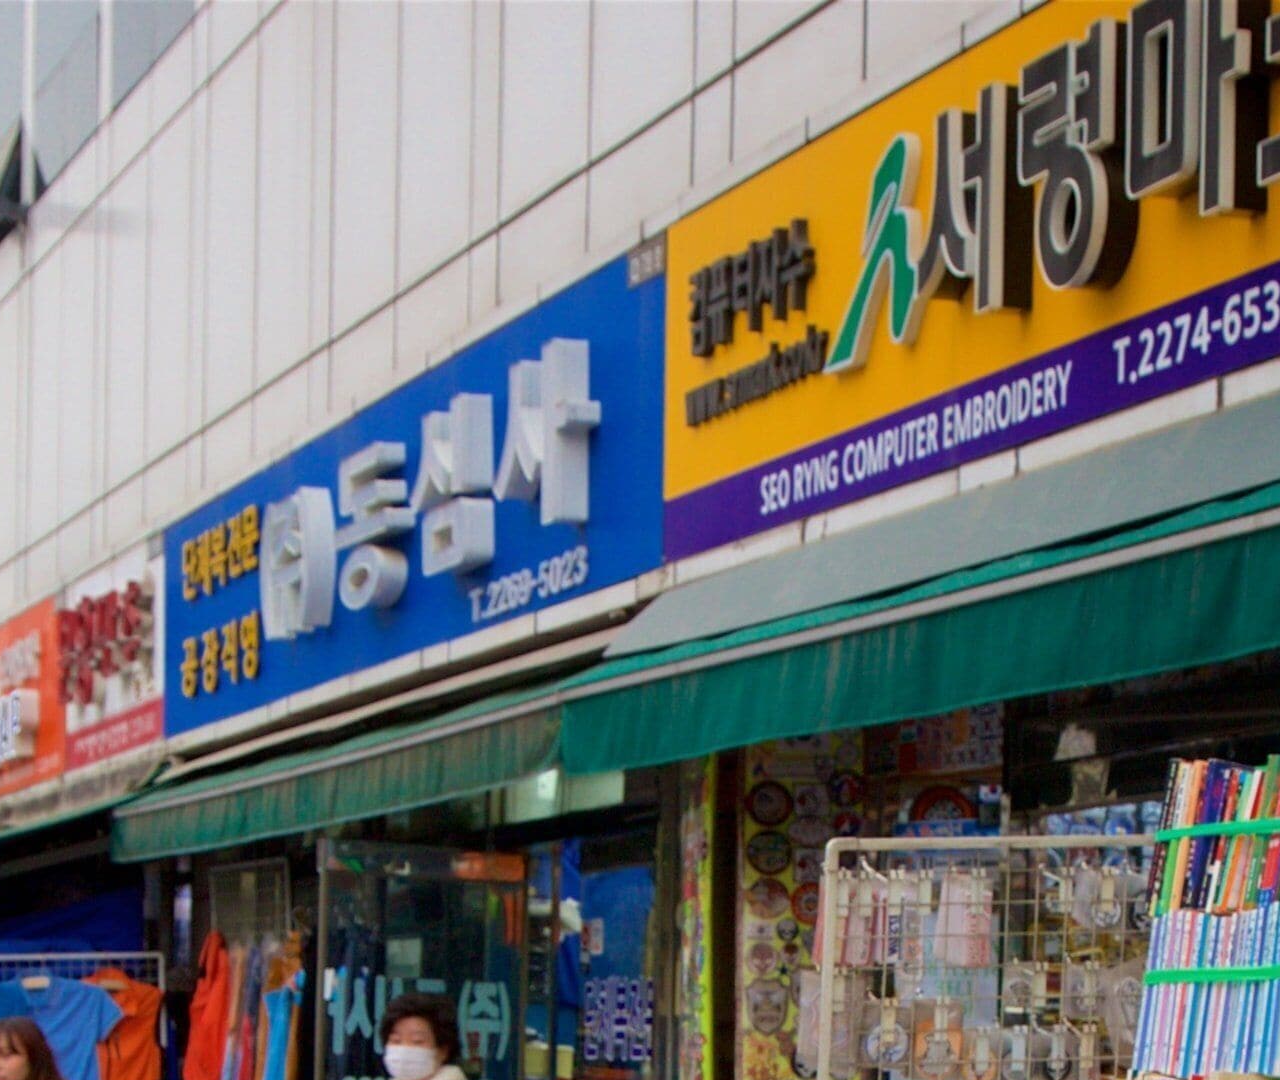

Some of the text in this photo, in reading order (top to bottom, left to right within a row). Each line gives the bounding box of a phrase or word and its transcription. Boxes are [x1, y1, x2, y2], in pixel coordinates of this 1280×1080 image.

[760, 474, 790, 515] SEO
[793, 449, 839, 504] RYNG
[841, 415, 939, 486] COMPUTER
[942, 360, 1074, 449] EMBROIDERY
[180, 610, 259, 698] 공장직영
